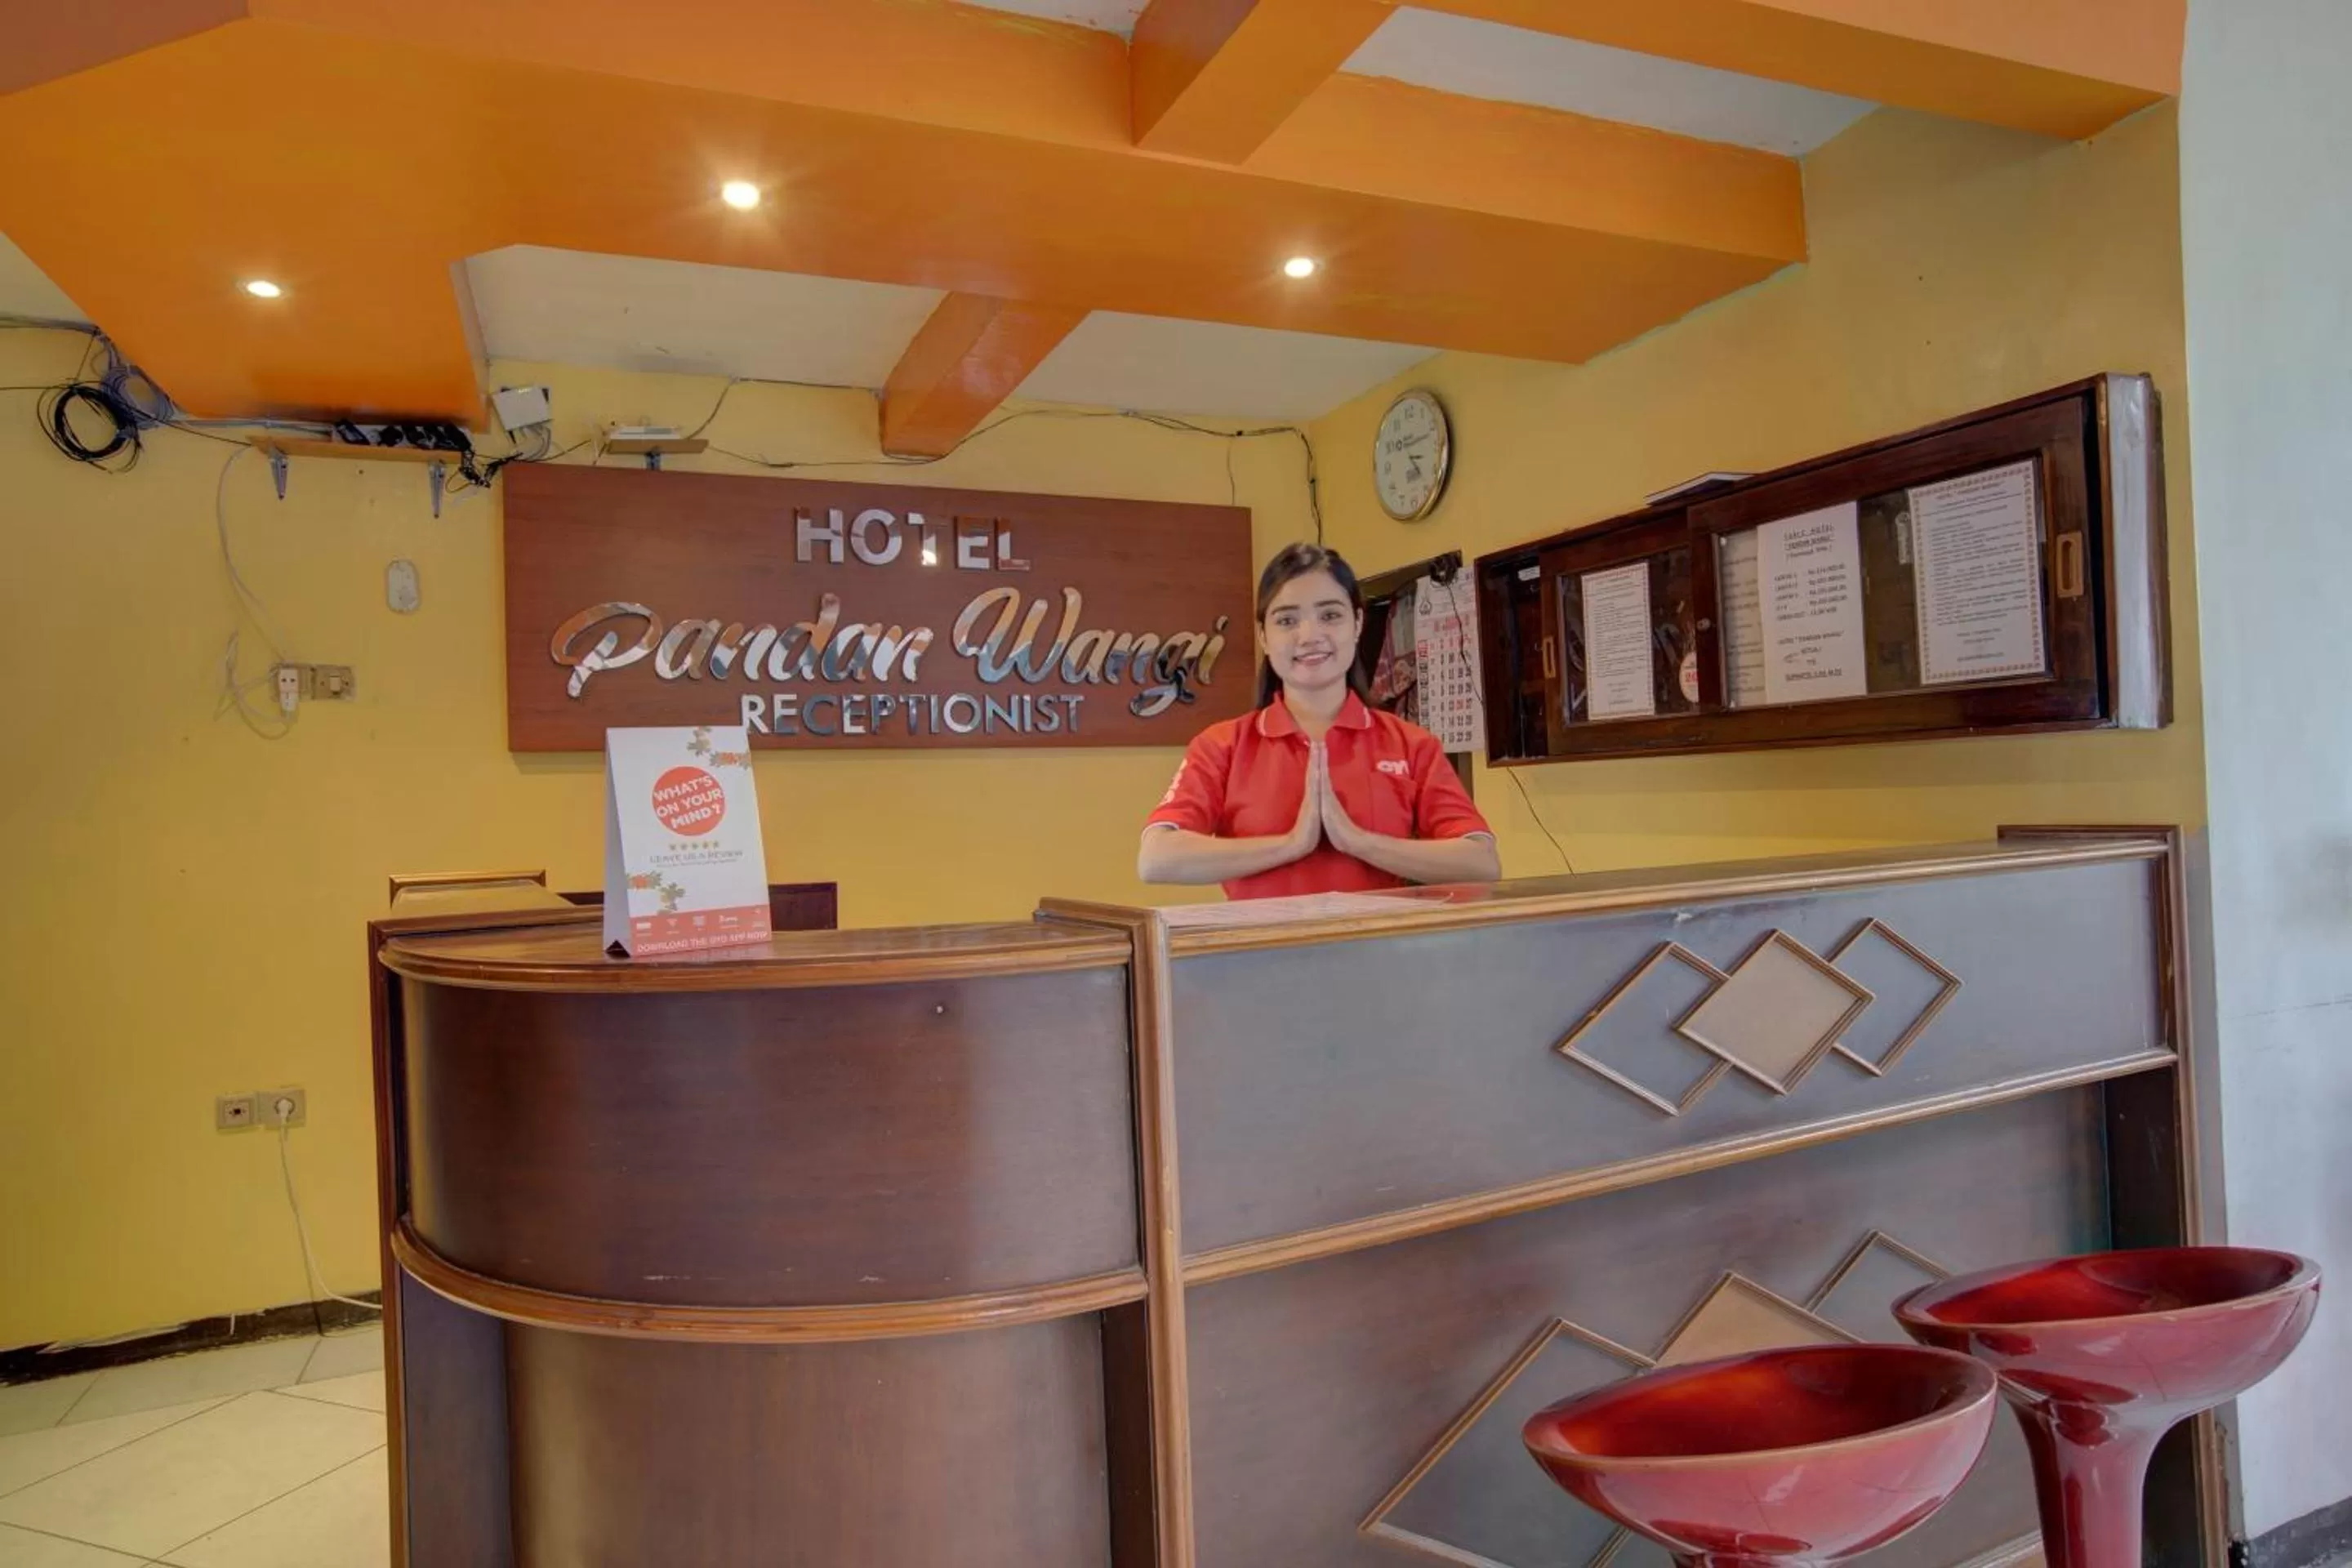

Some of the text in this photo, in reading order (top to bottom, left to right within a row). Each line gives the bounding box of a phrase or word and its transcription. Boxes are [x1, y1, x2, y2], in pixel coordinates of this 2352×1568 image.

[795, 506, 1032, 573] HOTEL
[551, 585, 1229, 718] Pandan Wangi
[741, 693, 1085, 738] RECEPTIONIST
[653, 775, 714, 801] WHAT'S
[657, 788, 724, 817] ON YOUR
[670, 803, 721, 830] MIND?
[637, 939, 688, 952] DOWNLOAD
[689, 937, 706, 947] THE
[729, 933, 745, 942] APP
[747, 930, 768, 940] NOW
